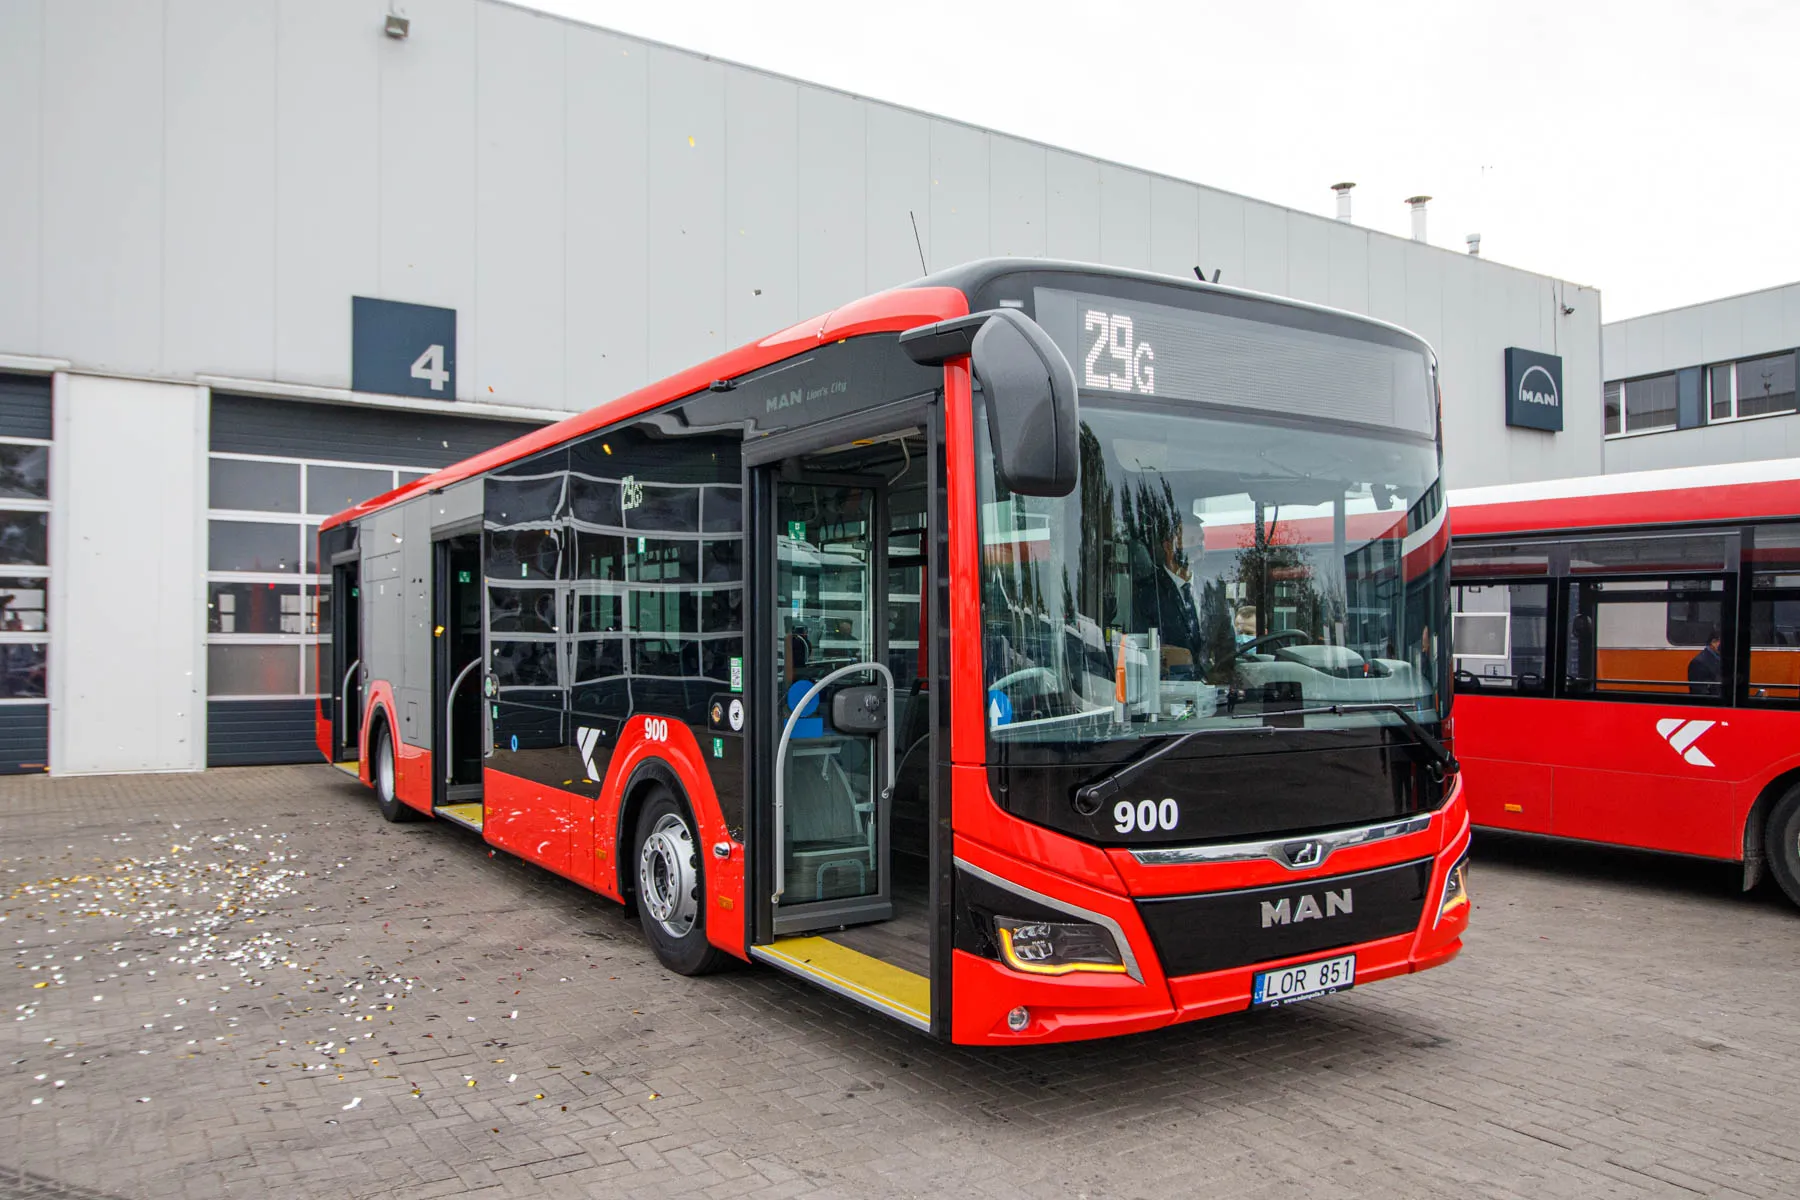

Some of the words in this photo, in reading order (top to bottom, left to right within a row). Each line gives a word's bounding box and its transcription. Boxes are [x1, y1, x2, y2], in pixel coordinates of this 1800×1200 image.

[411, 344, 449, 391] 4
[766, 388, 802, 413] MAN
[806, 386, 829, 401] Lion's
[831, 382, 847, 394] City
[1522, 389, 1555, 406] MAN
[644, 717, 668, 742] 900
[1113, 798, 1179, 834] 900
[1260, 888, 1353, 928] MAN
[1266, 969, 1307, 998] LOR
[1319, 959, 1350, 986] 851
